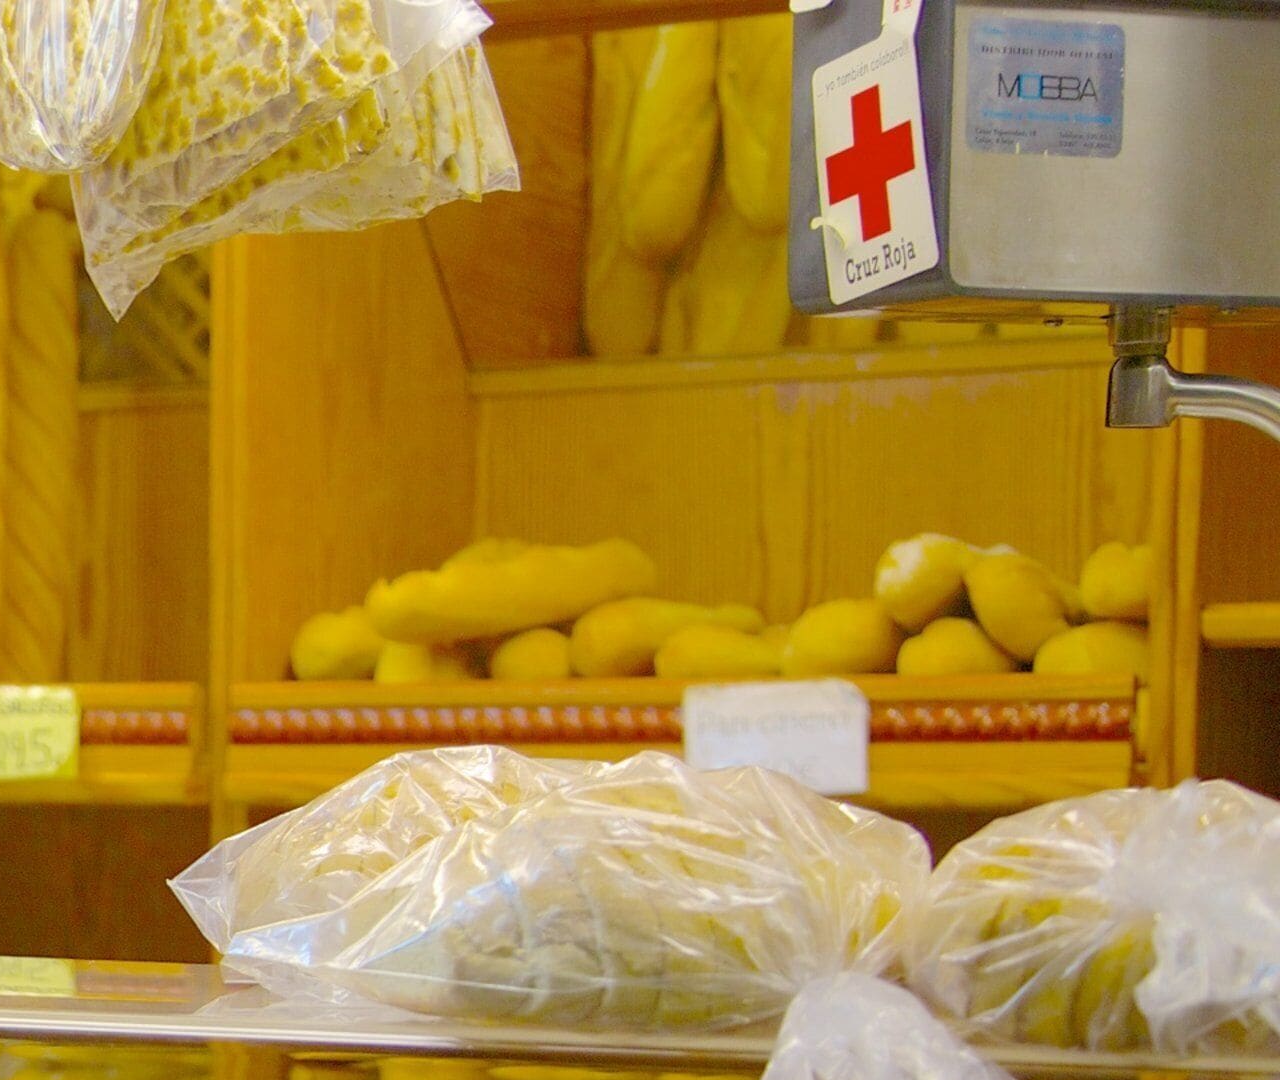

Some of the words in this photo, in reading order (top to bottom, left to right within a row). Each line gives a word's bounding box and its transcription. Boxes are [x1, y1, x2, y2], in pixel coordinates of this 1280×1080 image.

[998, 72, 1098, 101] MOBBA
[845, 258, 880, 284] Cruz
[882, 237, 916, 271] Roja
